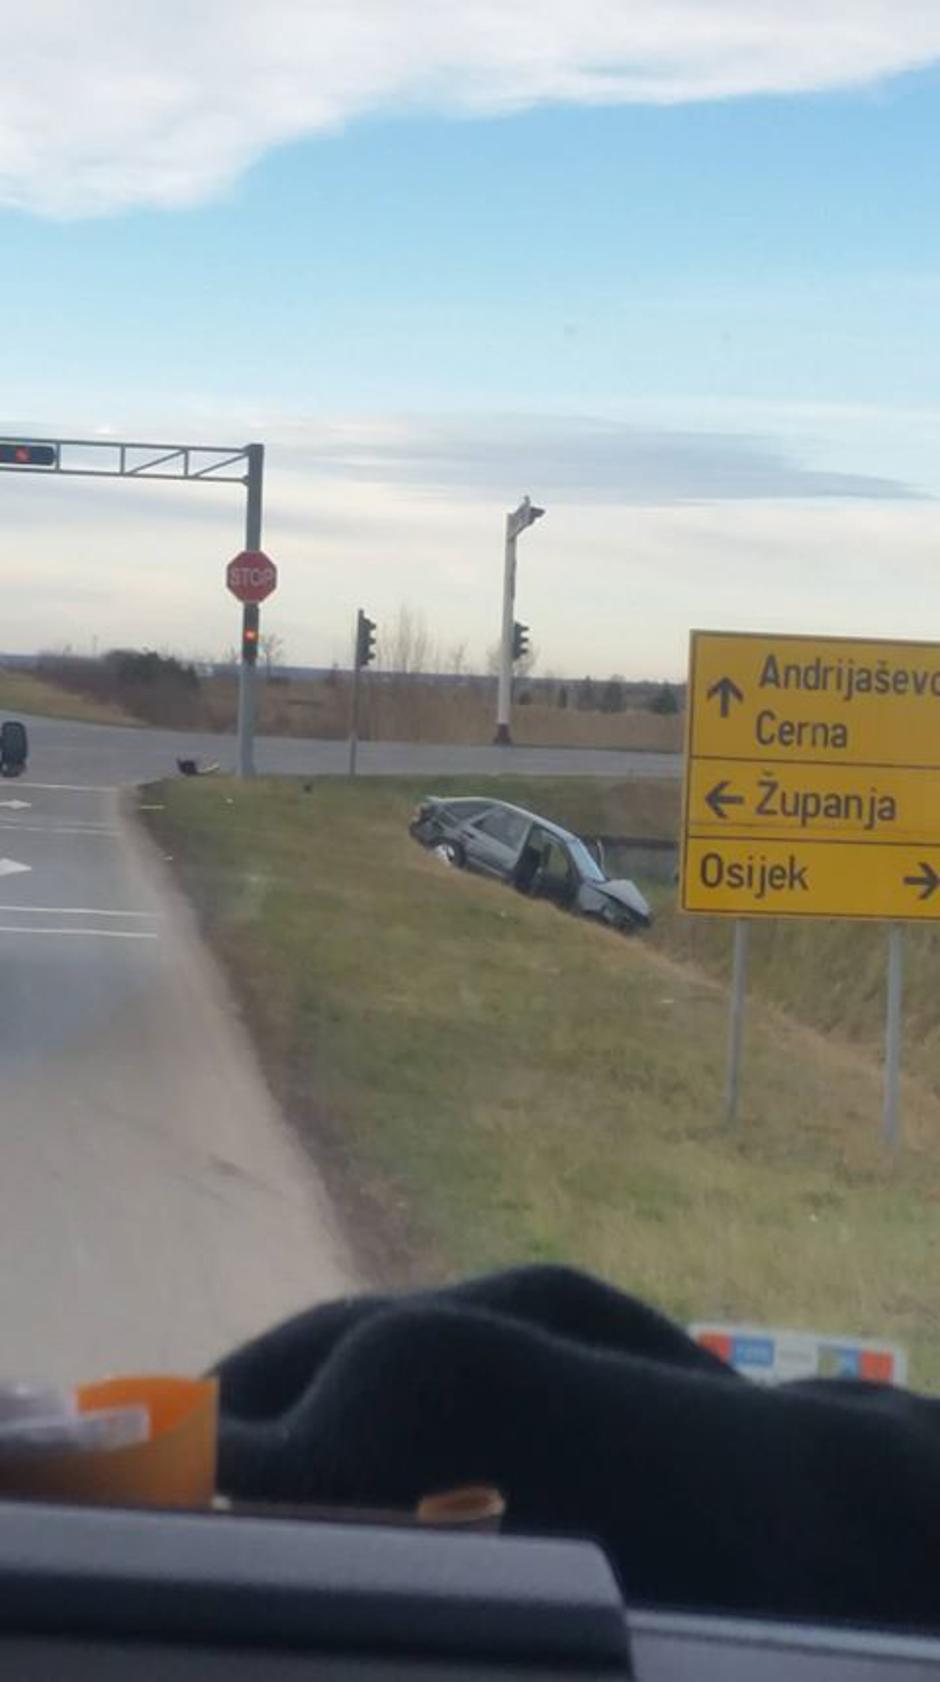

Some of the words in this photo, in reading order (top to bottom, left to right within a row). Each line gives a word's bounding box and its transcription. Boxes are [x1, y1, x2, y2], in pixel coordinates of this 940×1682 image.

[230, 567, 275, 587] STOP
[755, 709, 848, 748] Cerna
[755, 771, 897, 829] Županja
[699, 852, 809, 899] Osijek
